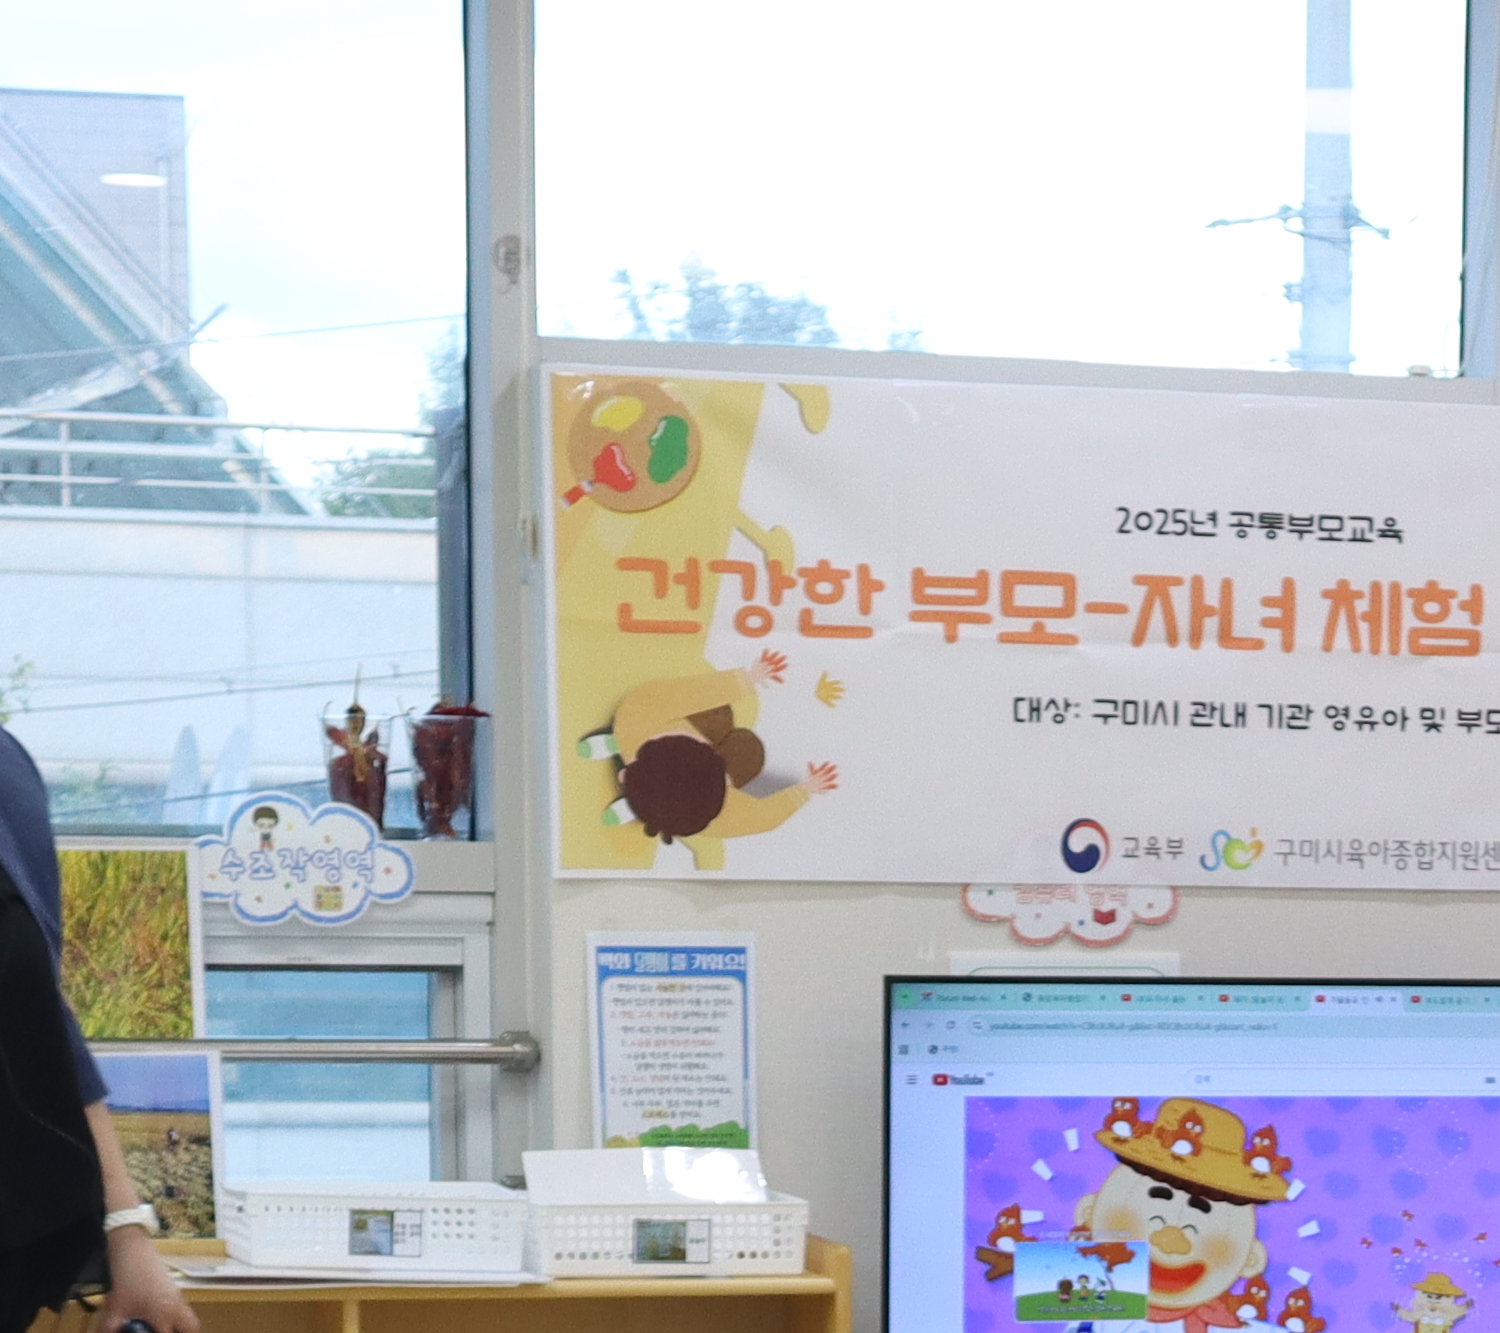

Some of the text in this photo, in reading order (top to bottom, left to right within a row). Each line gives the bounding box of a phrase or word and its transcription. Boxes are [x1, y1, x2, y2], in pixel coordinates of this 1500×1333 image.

[1115, 506, 1404, 543] 2025년 공통부모교육
[615, 556, 886, 640] 건강한
[907, 566, 1297, 653] 부모-자녀
[1320, 578, 1484, 657] 체험
[1012, 697, 1080, 725] 대상:
[1092, 698, 1180, 727] 구미시
[1189, 700, 1248, 729] 관내
[1256, 702, 1315, 731] 기관
[1322, 704, 1409, 733] 영유아
[1419, 706, 1448, 734] 및
[1120, 836, 1186, 860] 교육부
